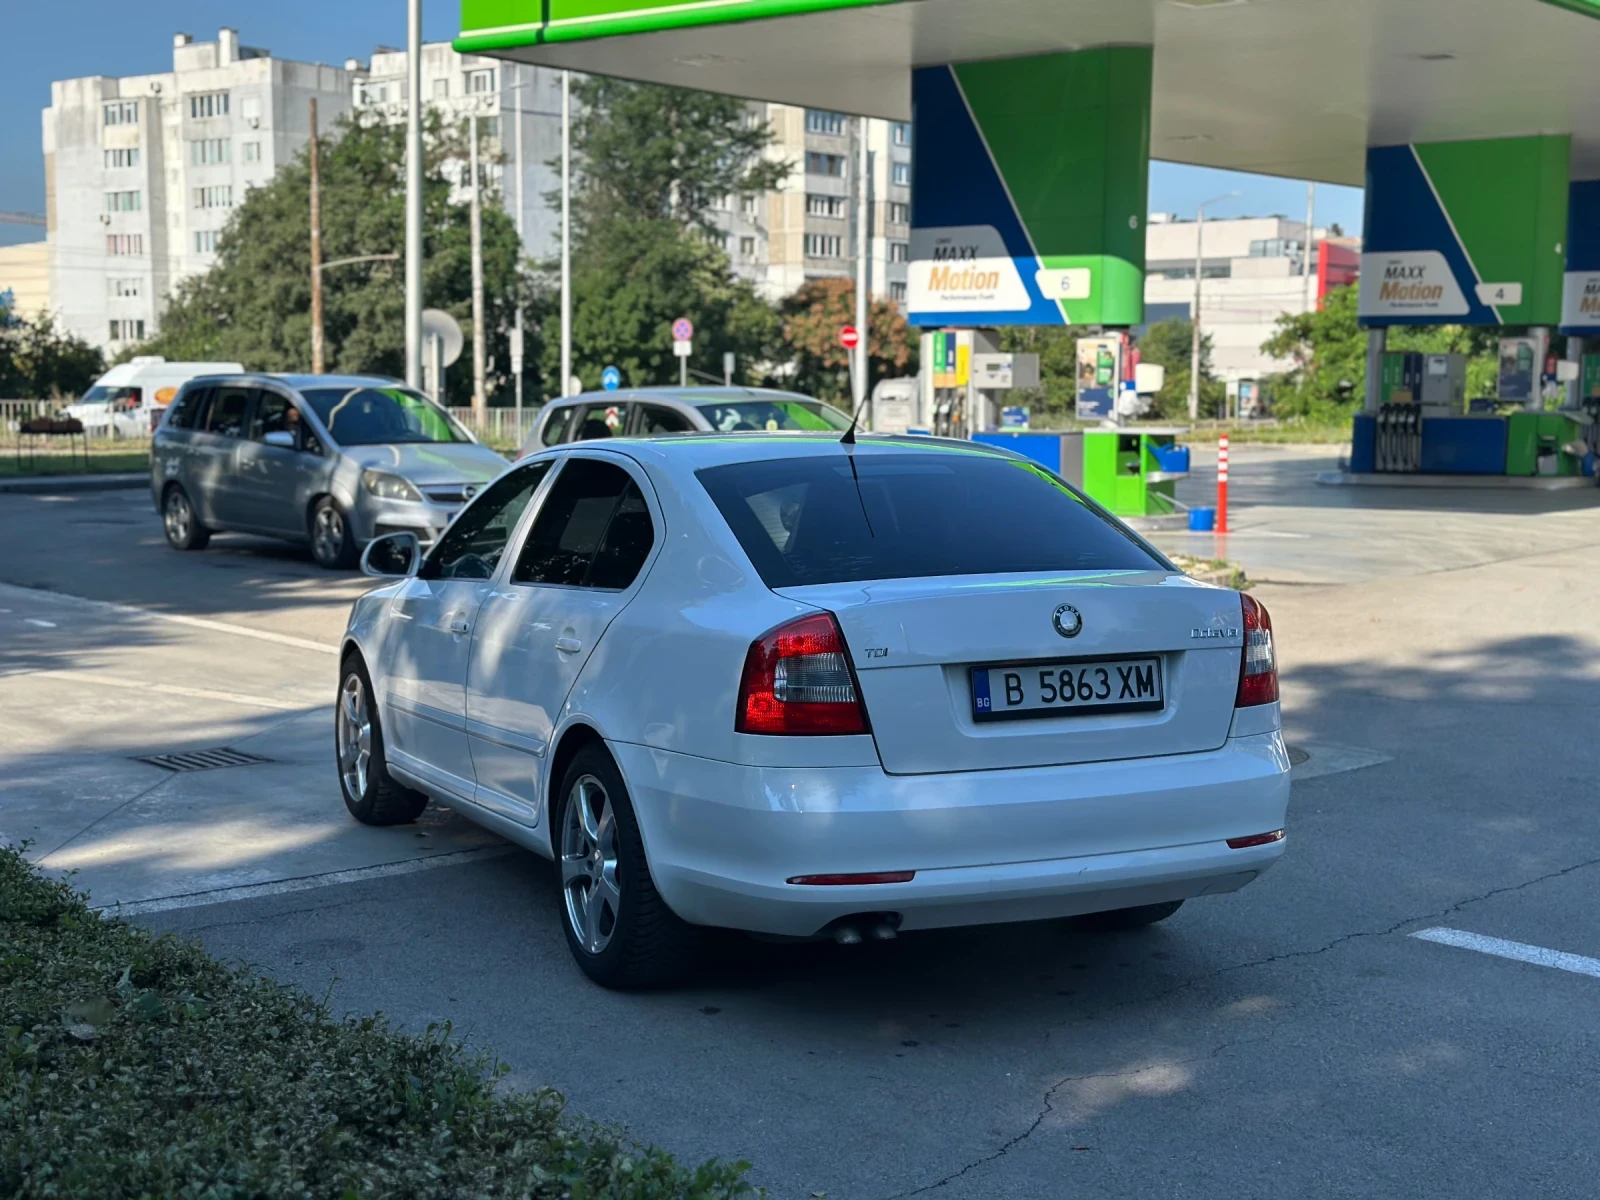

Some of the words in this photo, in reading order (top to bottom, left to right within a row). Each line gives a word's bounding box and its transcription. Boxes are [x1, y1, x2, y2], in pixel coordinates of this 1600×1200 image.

[1128, 215, 1138, 229] 6
[933, 246, 978, 261] MAXX
[928, 265, 999, 291] Motion
[1384, 265, 1426, 279] MAXX
[1061, 276, 1070, 290] 6
[1380, 280, 1443, 300] Motion
[1495, 288, 1504, 299] 4
[864, 647, 889, 658] TDI
[1004, 673, 1024, 706] B
[1039, 667, 1111, 704] 5863
[1116, 664, 1155, 699] XM
[977, 697, 990, 708] BG
